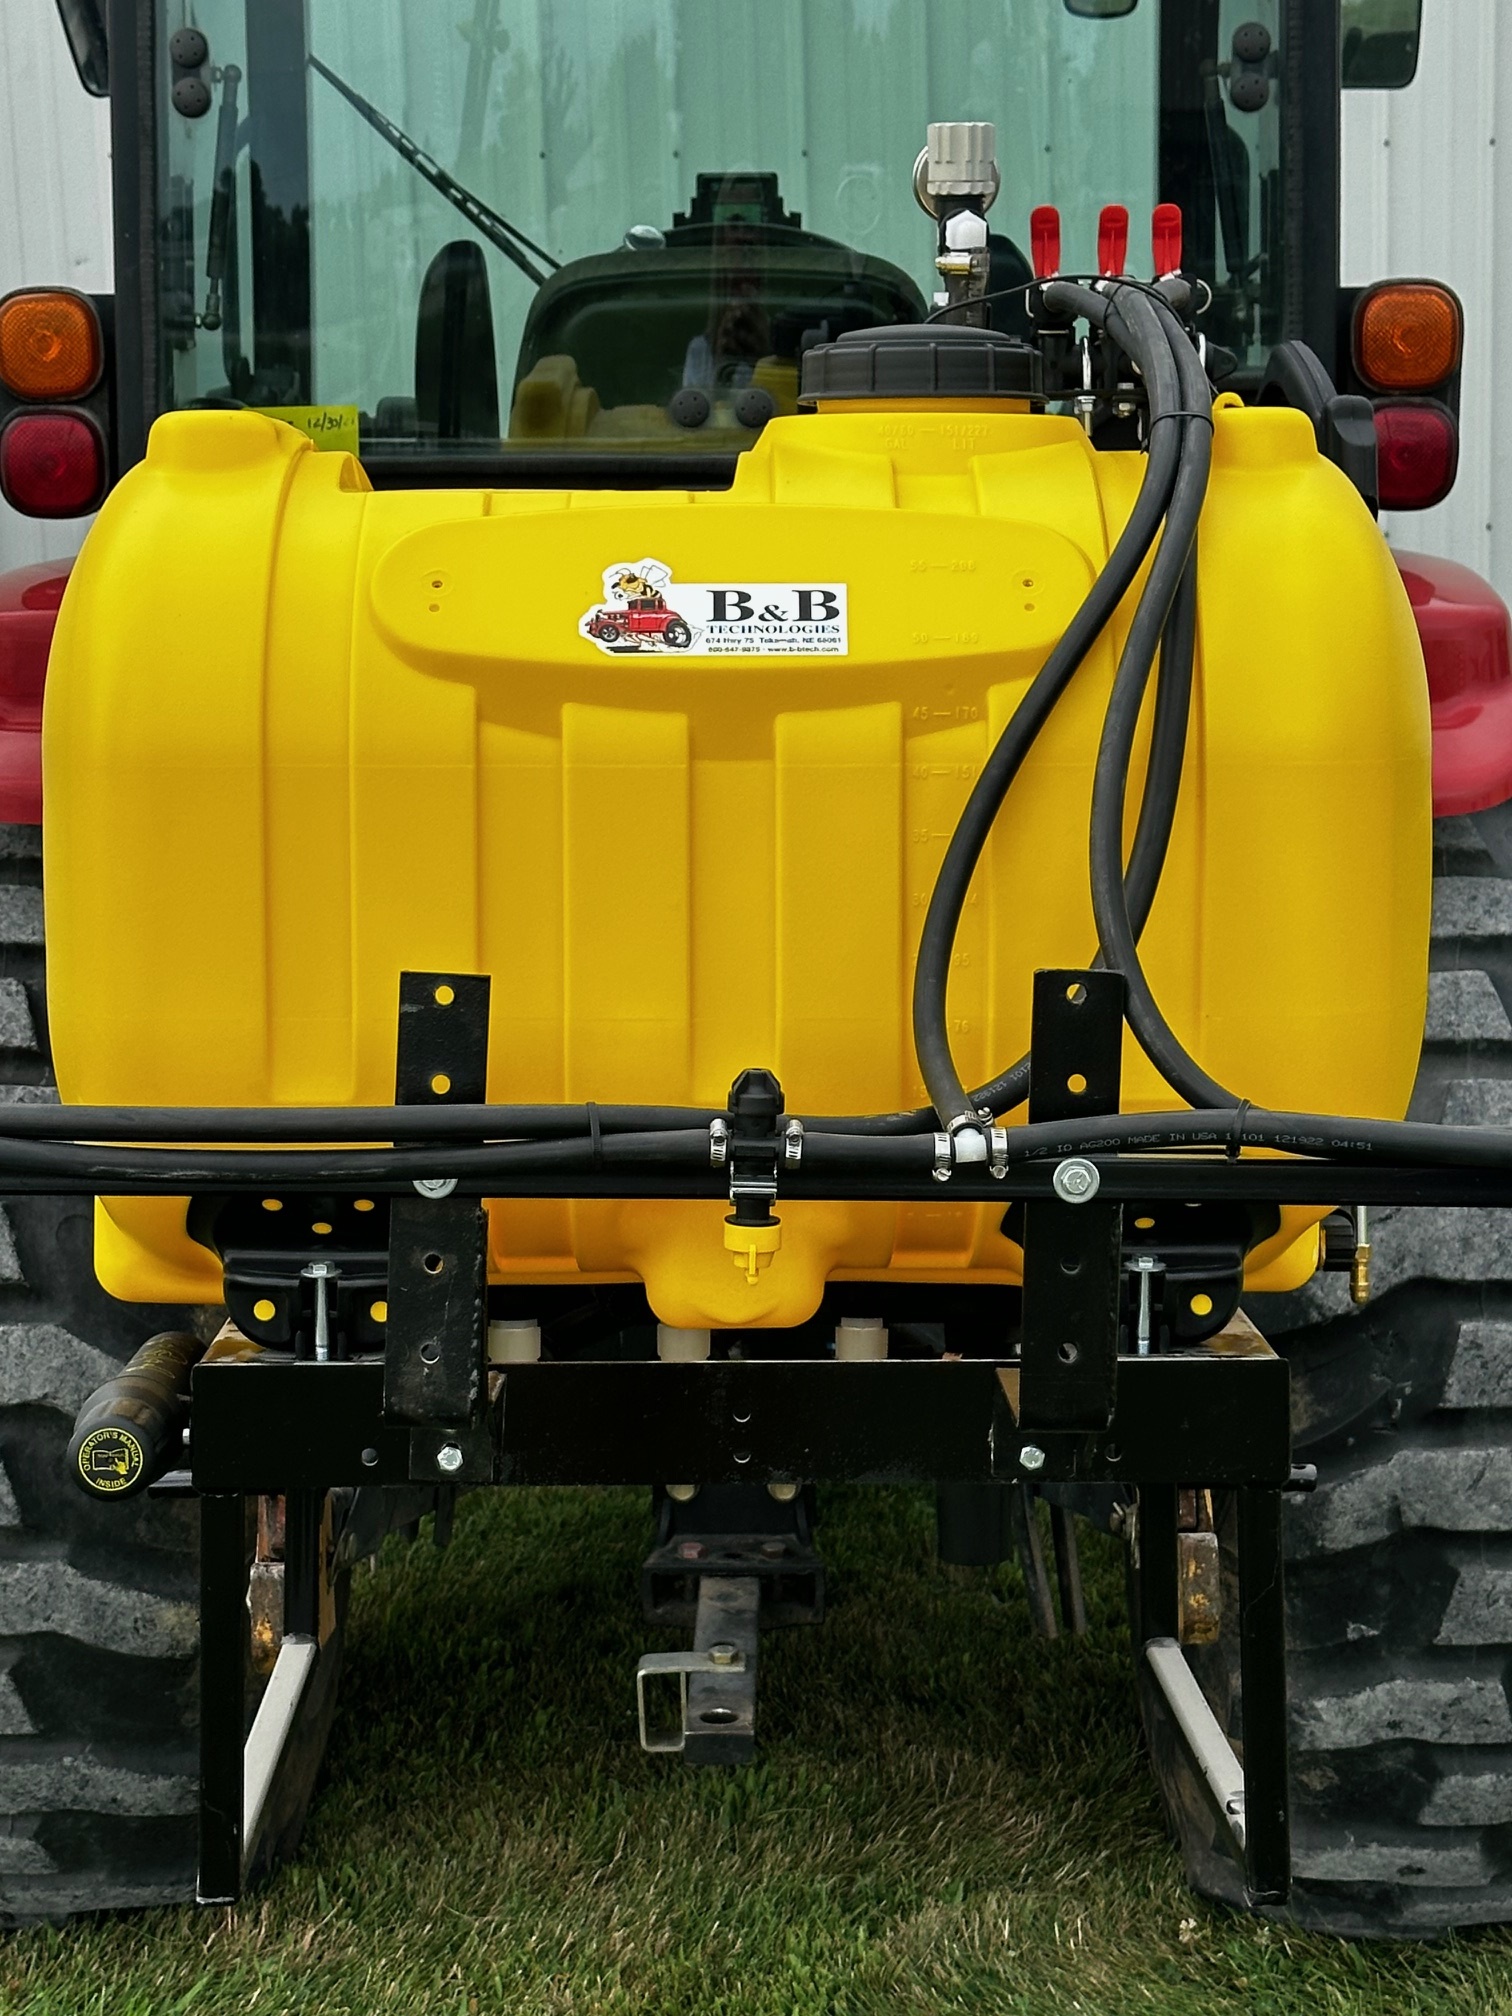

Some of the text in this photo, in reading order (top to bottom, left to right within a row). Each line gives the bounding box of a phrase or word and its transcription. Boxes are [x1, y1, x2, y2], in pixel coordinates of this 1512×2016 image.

[885, 437, 975, 450] GAL LIT
[705, 589, 840, 622] B&B
[705, 624, 840, 634] TECHNOLOGIES
[912, 631, 929, 644] 50
[912, 706, 978, 720] 45 170
[912, 765, 928, 778] 40
[912, 828, 928, 842] 35
[953, 952, 969, 966] 95
[953, 1019, 969, 1033] 76
[1024, 1146, 1048, 1157] 1/2
[1079, 1138, 1121, 1152] AG200
[1127, 1134, 1161, 1145] MADE
[1169, 1133, 1186, 1142] IN
[1192, 1132, 1218, 1141] USA
[1274, 1134, 1325, 1146] 121922
[1331, 1139, 1374, 1151] 04:51
[80, 1431, 139, 1471] OPERATOR'S MANUAL
[95, 1477, 127, 1488] INSIDE
